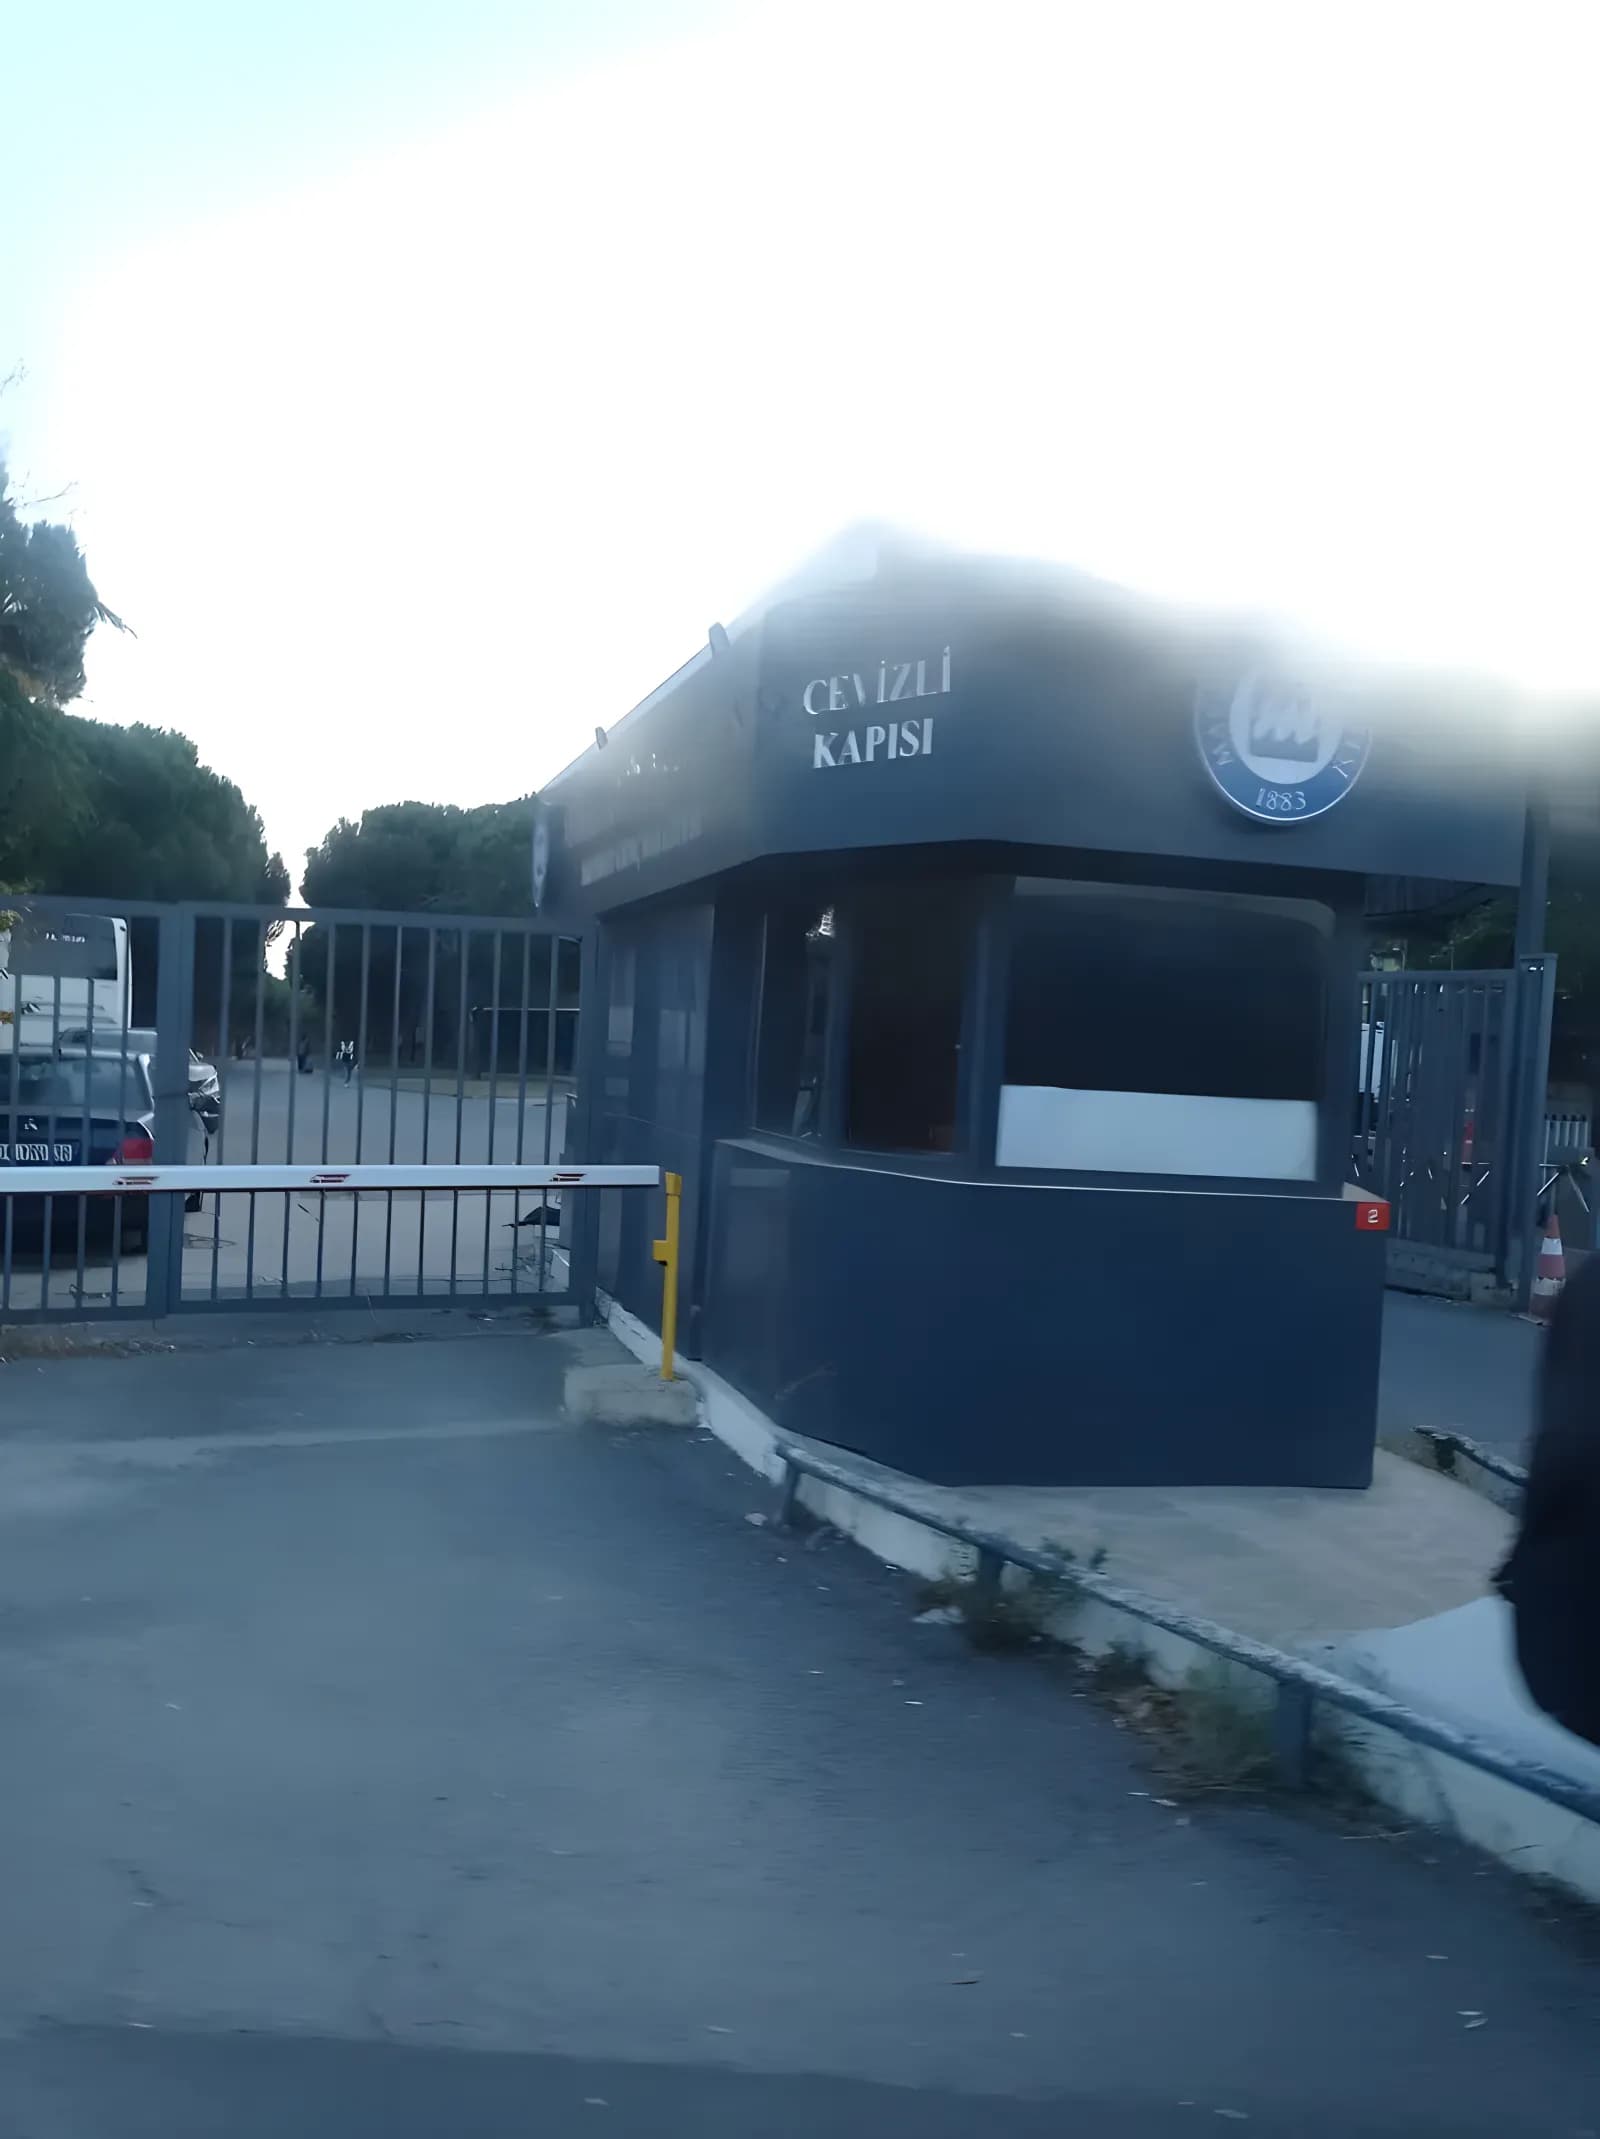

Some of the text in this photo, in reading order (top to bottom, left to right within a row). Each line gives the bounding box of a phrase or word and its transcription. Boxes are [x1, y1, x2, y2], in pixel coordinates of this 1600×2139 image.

[803, 645, 951, 715] CEVİZLİ
[813, 718, 934, 768] KAPISI
[1256, 788, 1306, 811] 1883
[1367, 1208, 1379, 1224] 2
